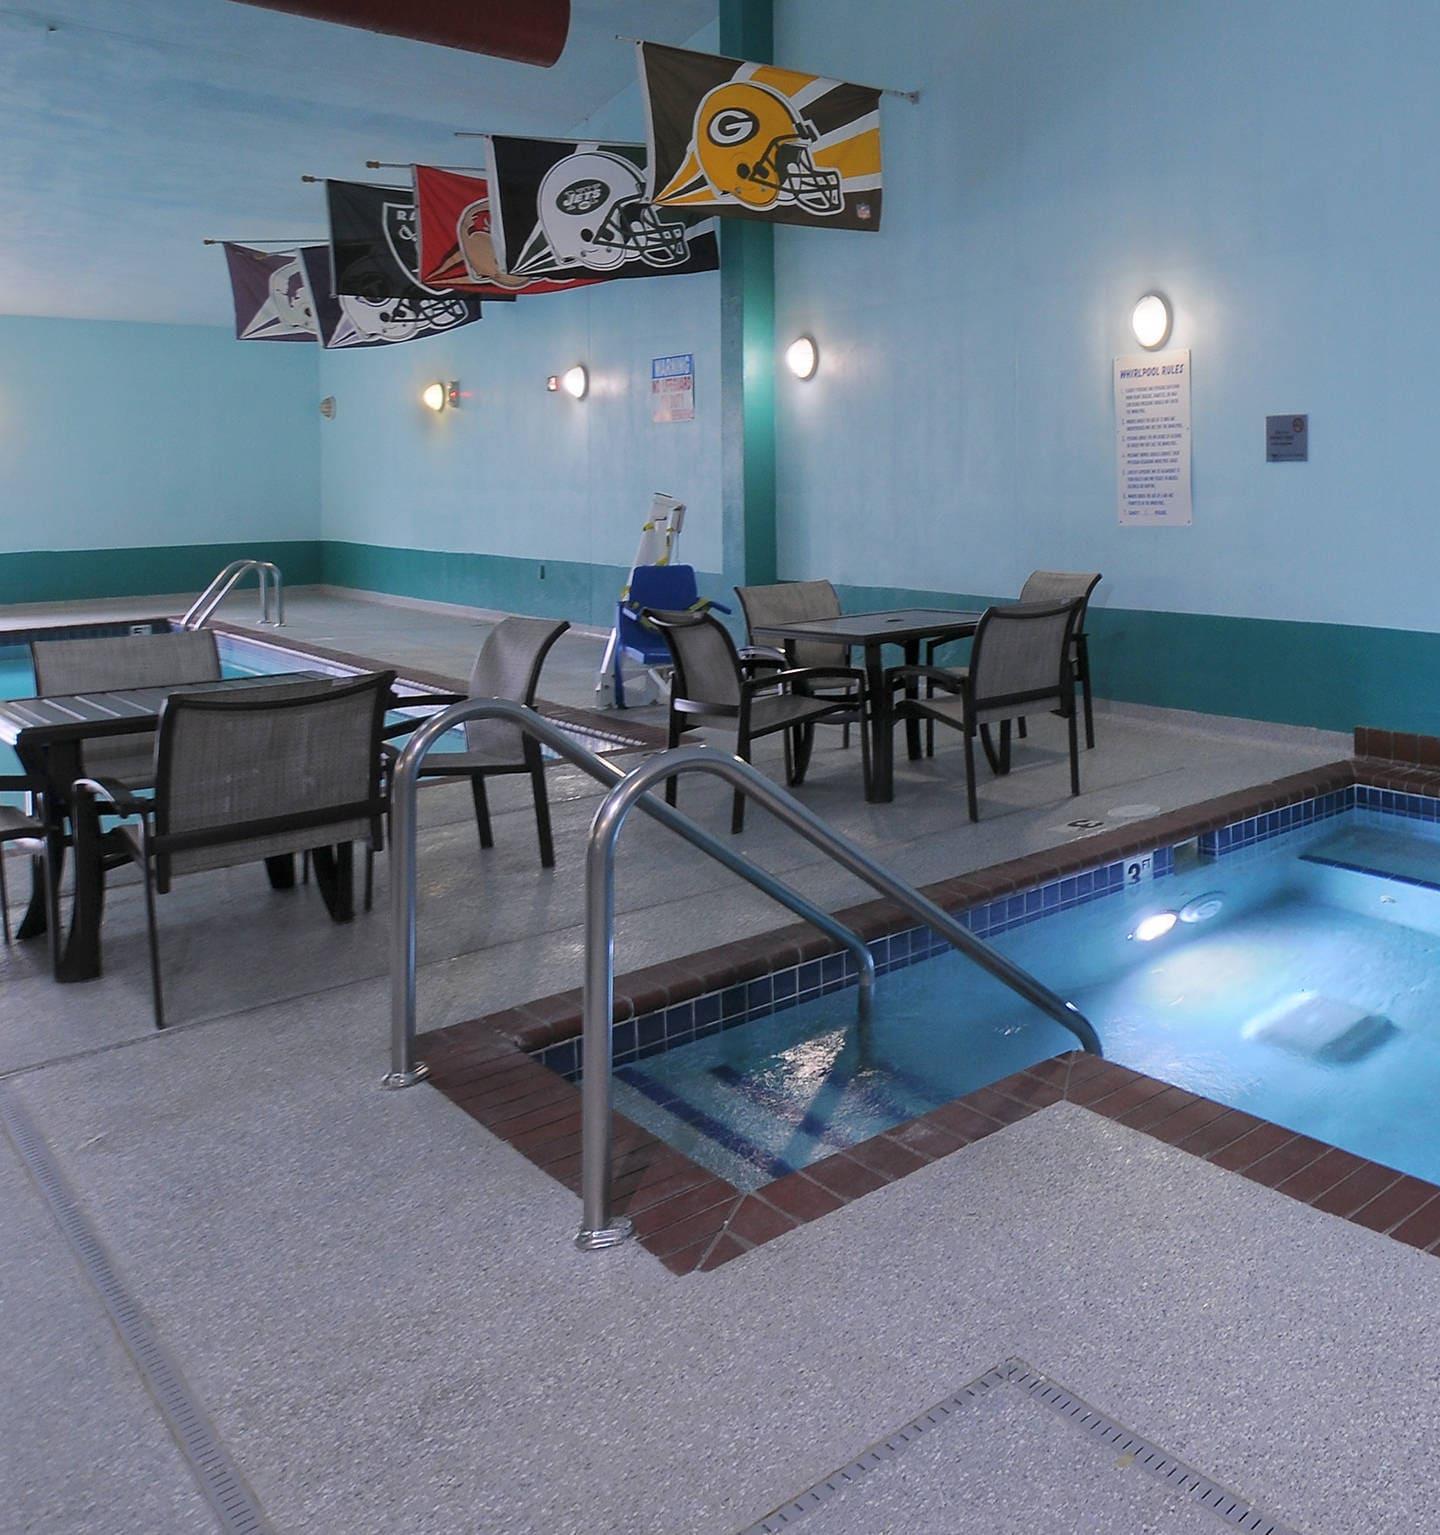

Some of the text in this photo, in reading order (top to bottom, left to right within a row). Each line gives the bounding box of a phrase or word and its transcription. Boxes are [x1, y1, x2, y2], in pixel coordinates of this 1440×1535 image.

[710, 110, 753, 144] G
[562, 188, 601, 207] JETS
[1120, 363, 1184, 379] WHIRLPOOL RULES
[1128, 858, 1151, 886] 3 FT
